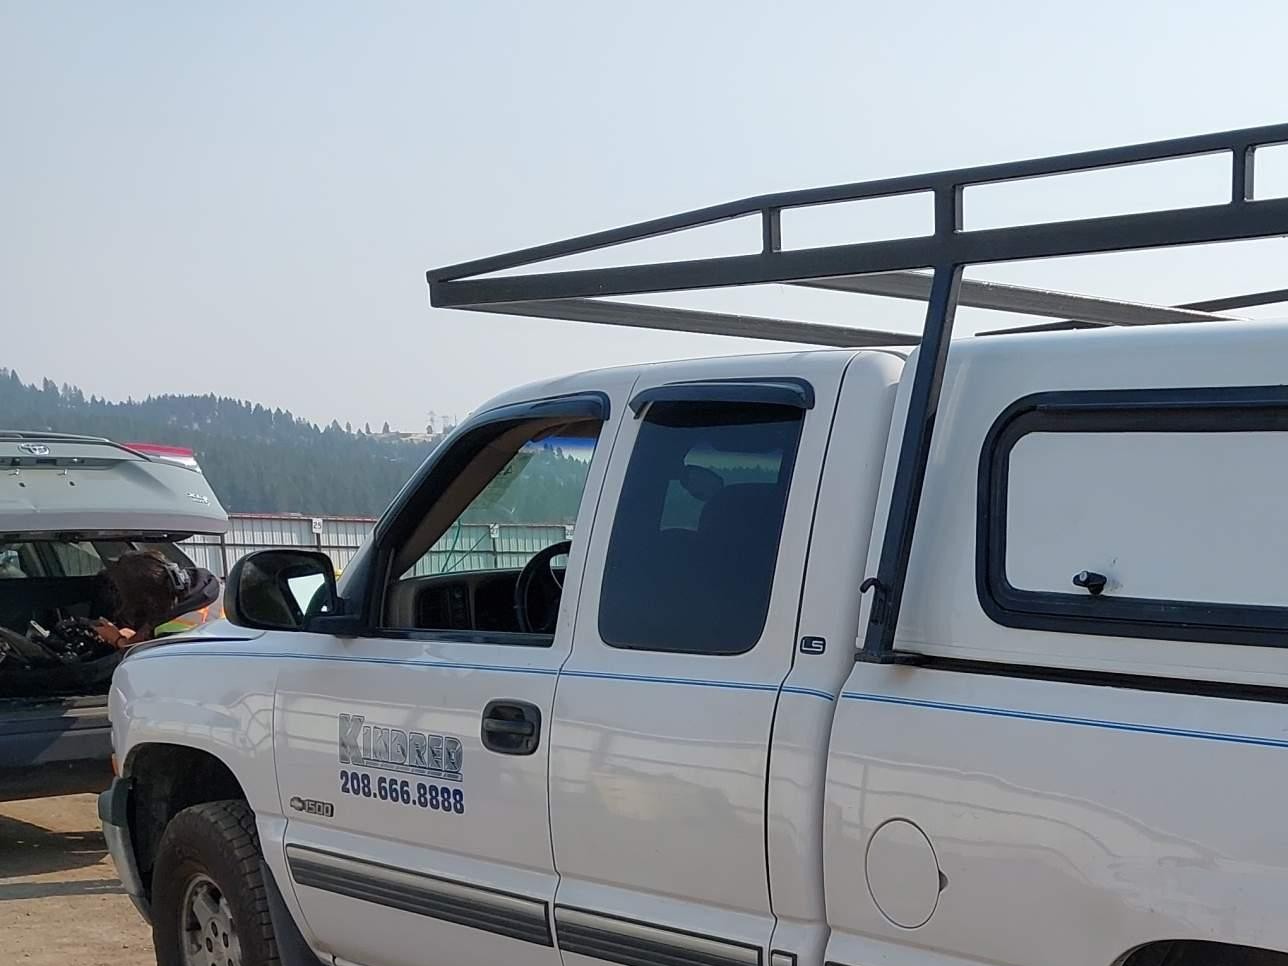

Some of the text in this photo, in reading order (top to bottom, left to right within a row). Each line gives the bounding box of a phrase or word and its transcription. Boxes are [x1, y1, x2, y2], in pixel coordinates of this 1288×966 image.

[802, 639, 824, 652] LS
[340, 769, 465, 815] 208.666.8888
[305, 799, 333, 817] 1500
